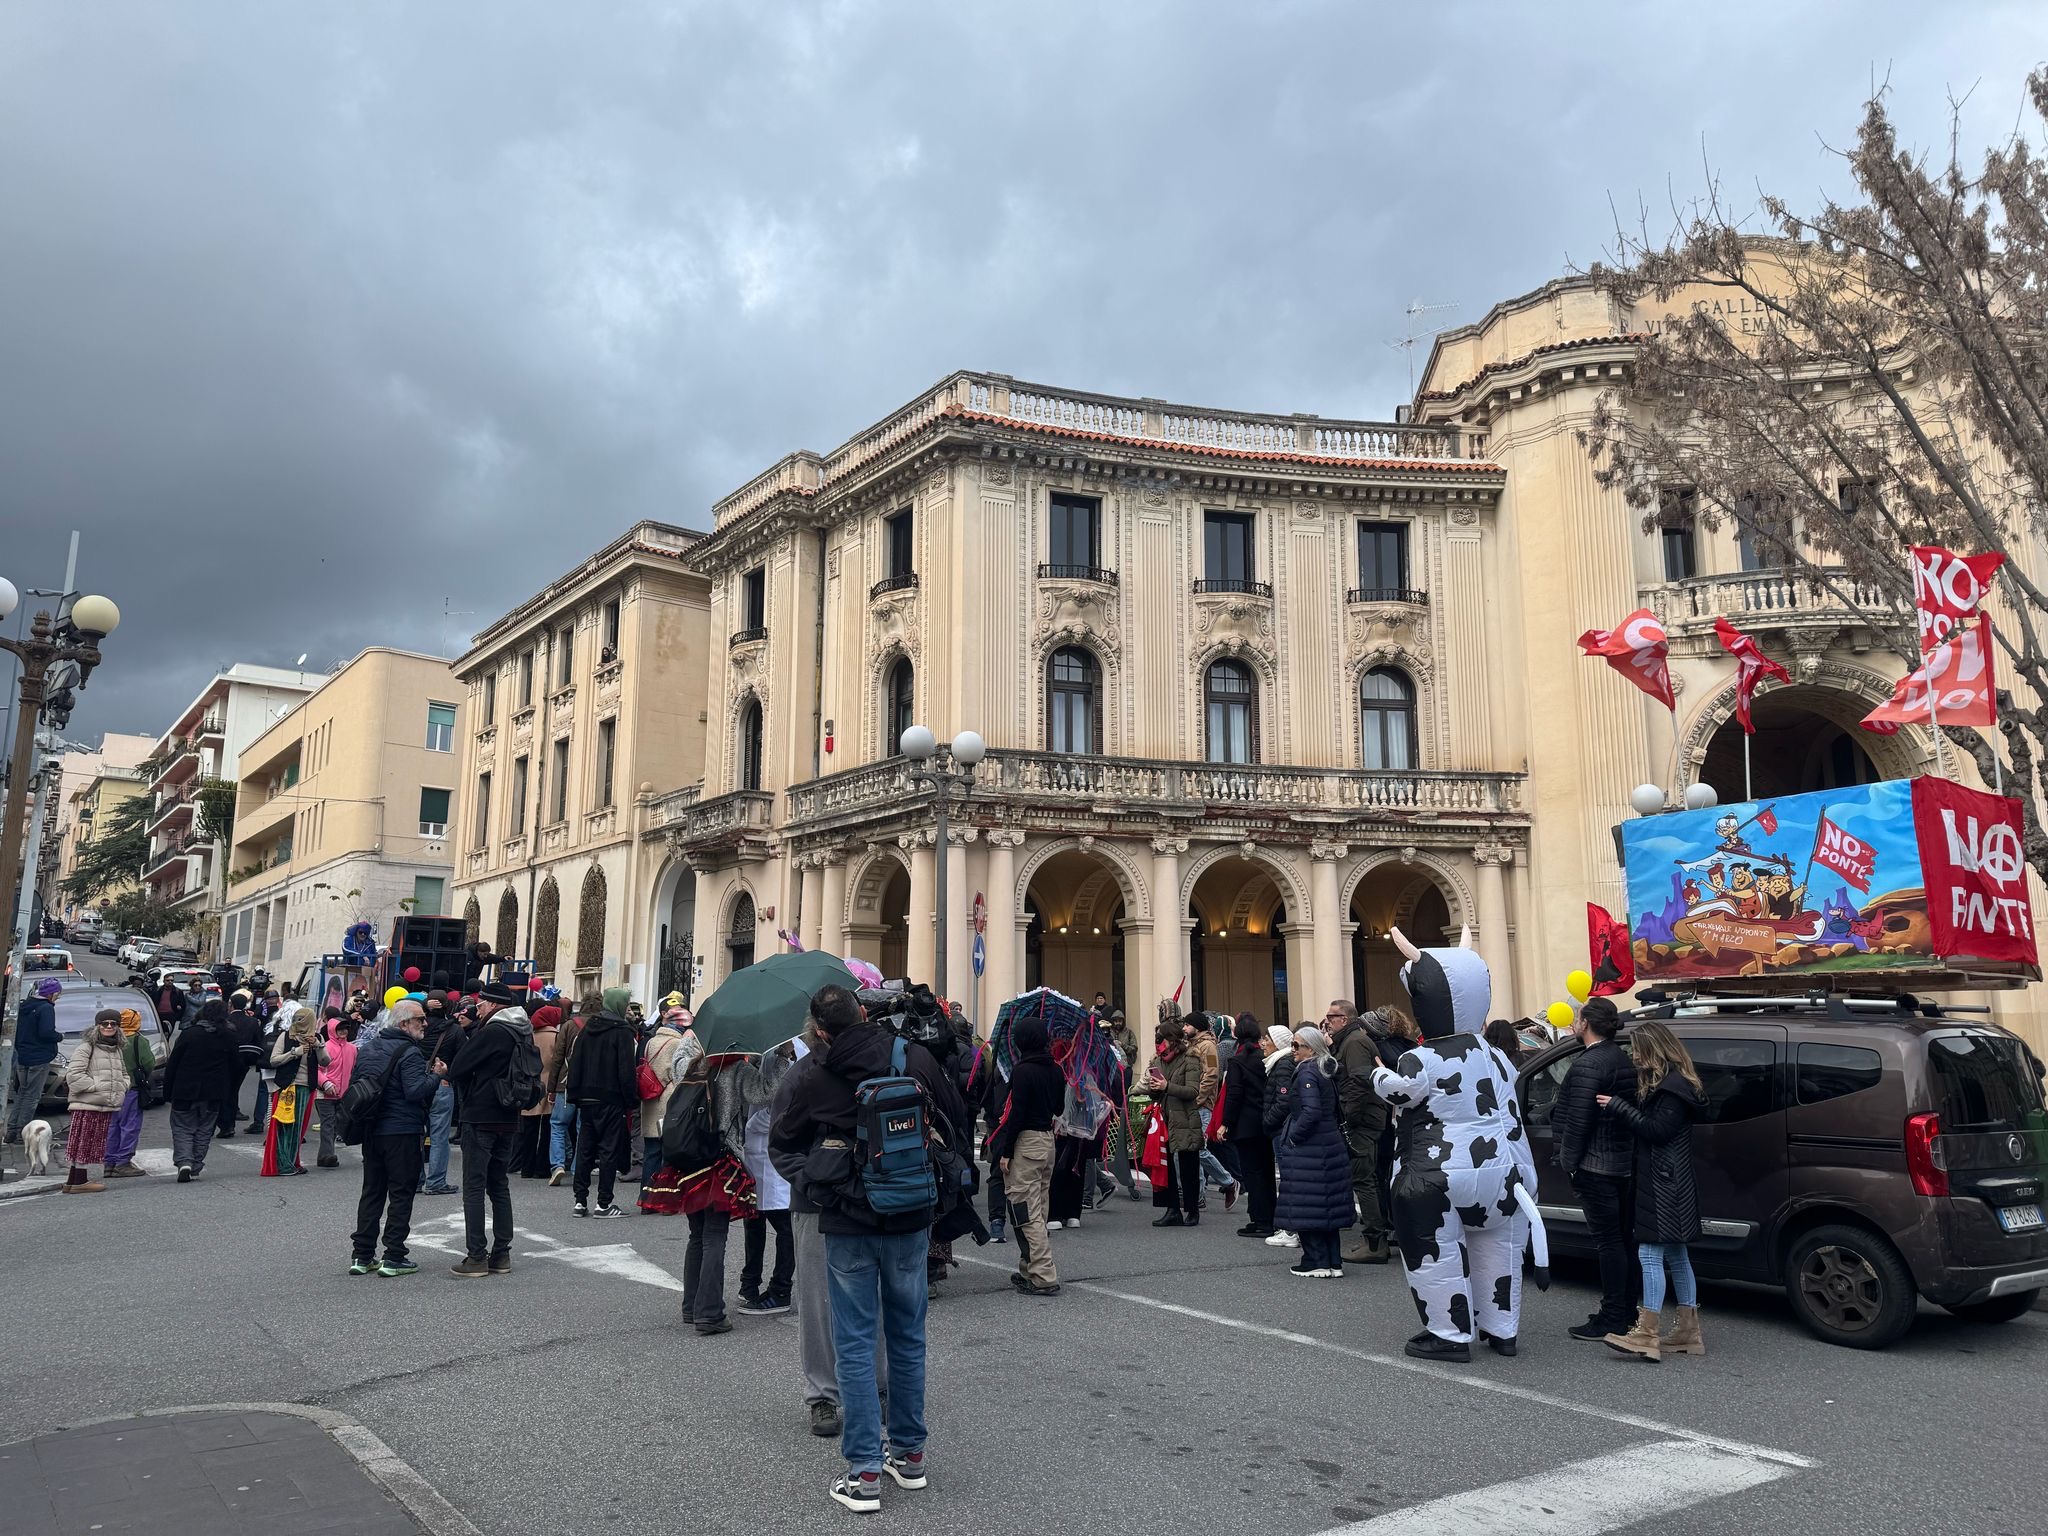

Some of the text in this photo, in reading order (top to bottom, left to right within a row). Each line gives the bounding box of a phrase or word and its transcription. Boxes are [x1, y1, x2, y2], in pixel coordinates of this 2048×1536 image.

[1913, 553, 1979, 611] NO
[1823, 821, 1861, 857] NO
[1818, 845, 1868, 880] PONTE
[1951, 886, 2031, 941] PNTE
